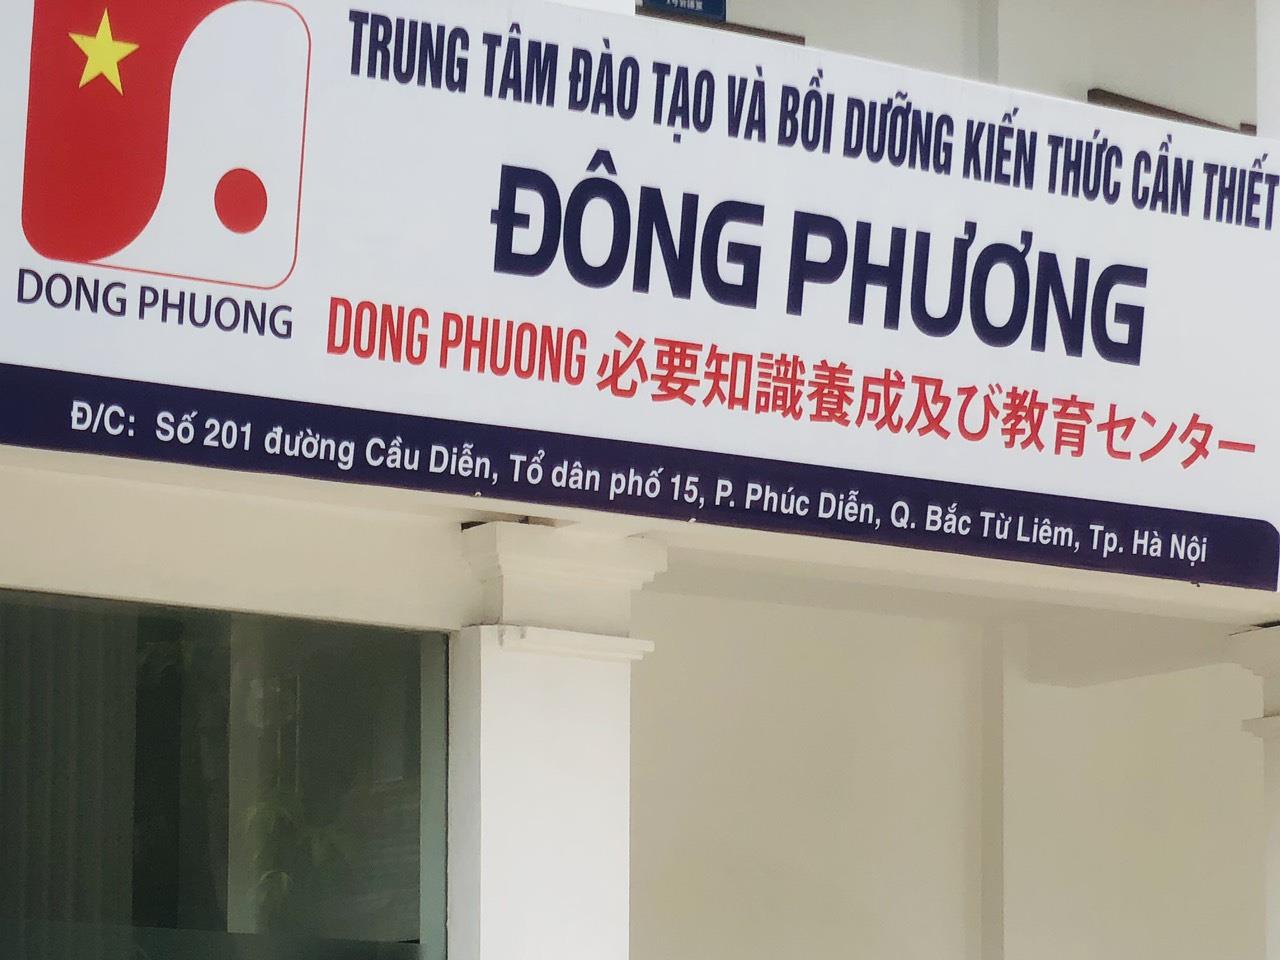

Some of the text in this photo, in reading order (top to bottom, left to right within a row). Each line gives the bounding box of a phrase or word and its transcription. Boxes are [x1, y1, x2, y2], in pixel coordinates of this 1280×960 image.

[348, 9, 1280, 231] TRUNG TÂM ĐÀO TẠO VÀ BỒI DƯỠNG KIẾN THỨC CẦN THIẾT
[17, 268, 293, 339] DONG PHUONG
[490, 148, 1148, 366] ĐÔNG PHƯƠNG
[326, 295, 1257, 470] DONG PHUONG 必要知識養成及び教育センター
[70, 400, 1208, 569] Đ/C: Số 201 đường Cầu Diễn, Tổ dân phố 15, P. Phúc Diễn, Q. Bắc Từ Liêm, Tp. Hà Nội
